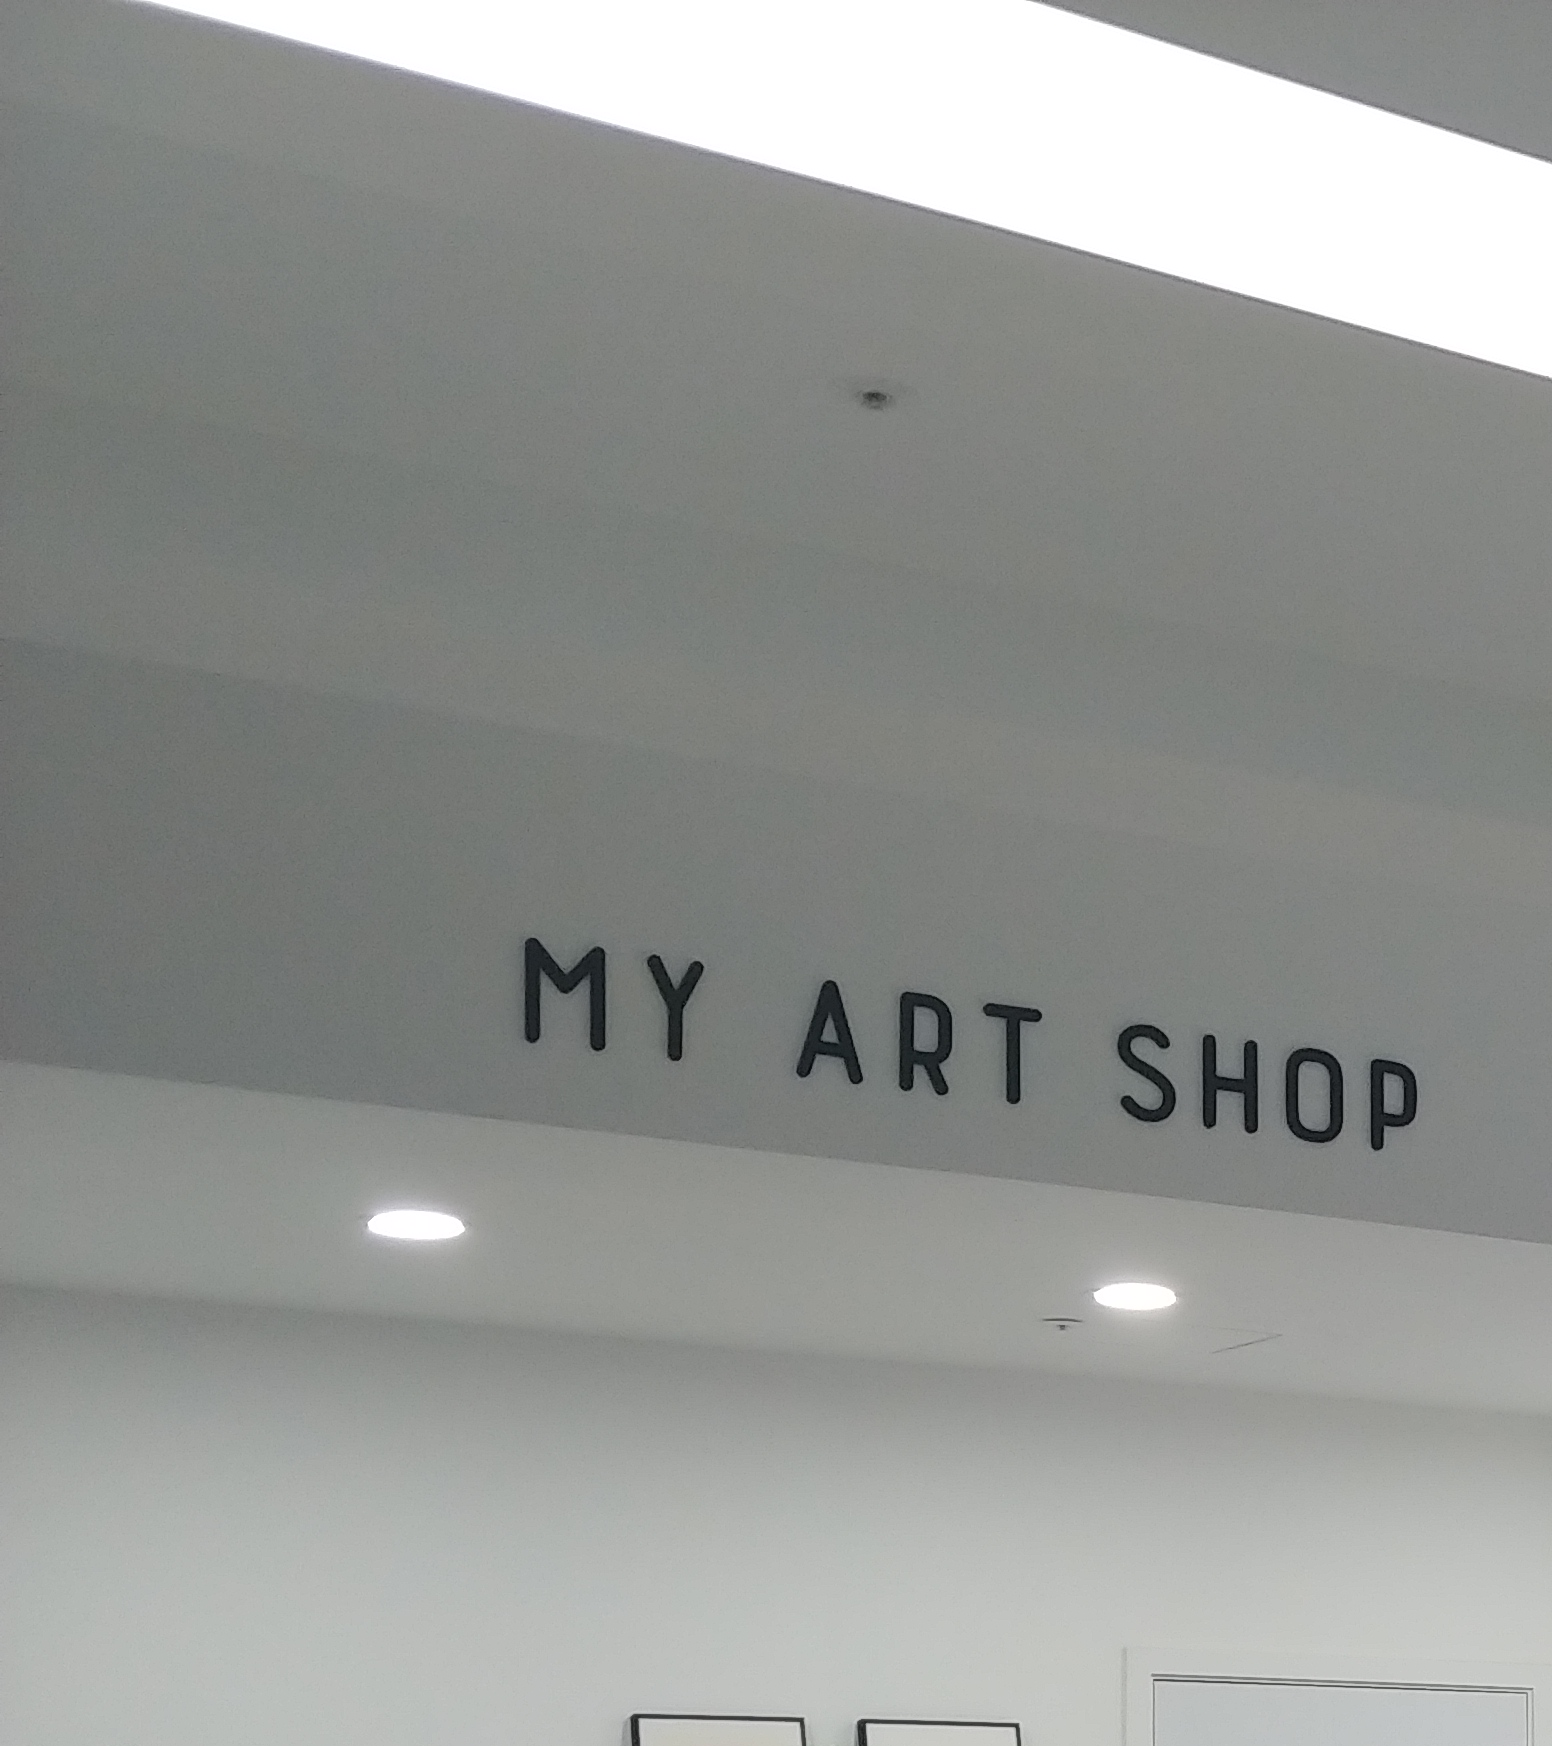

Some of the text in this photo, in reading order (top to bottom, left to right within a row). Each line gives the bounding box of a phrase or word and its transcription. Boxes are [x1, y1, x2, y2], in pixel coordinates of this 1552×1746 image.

[524, 936, 1418, 1152] MY ART SHOP
